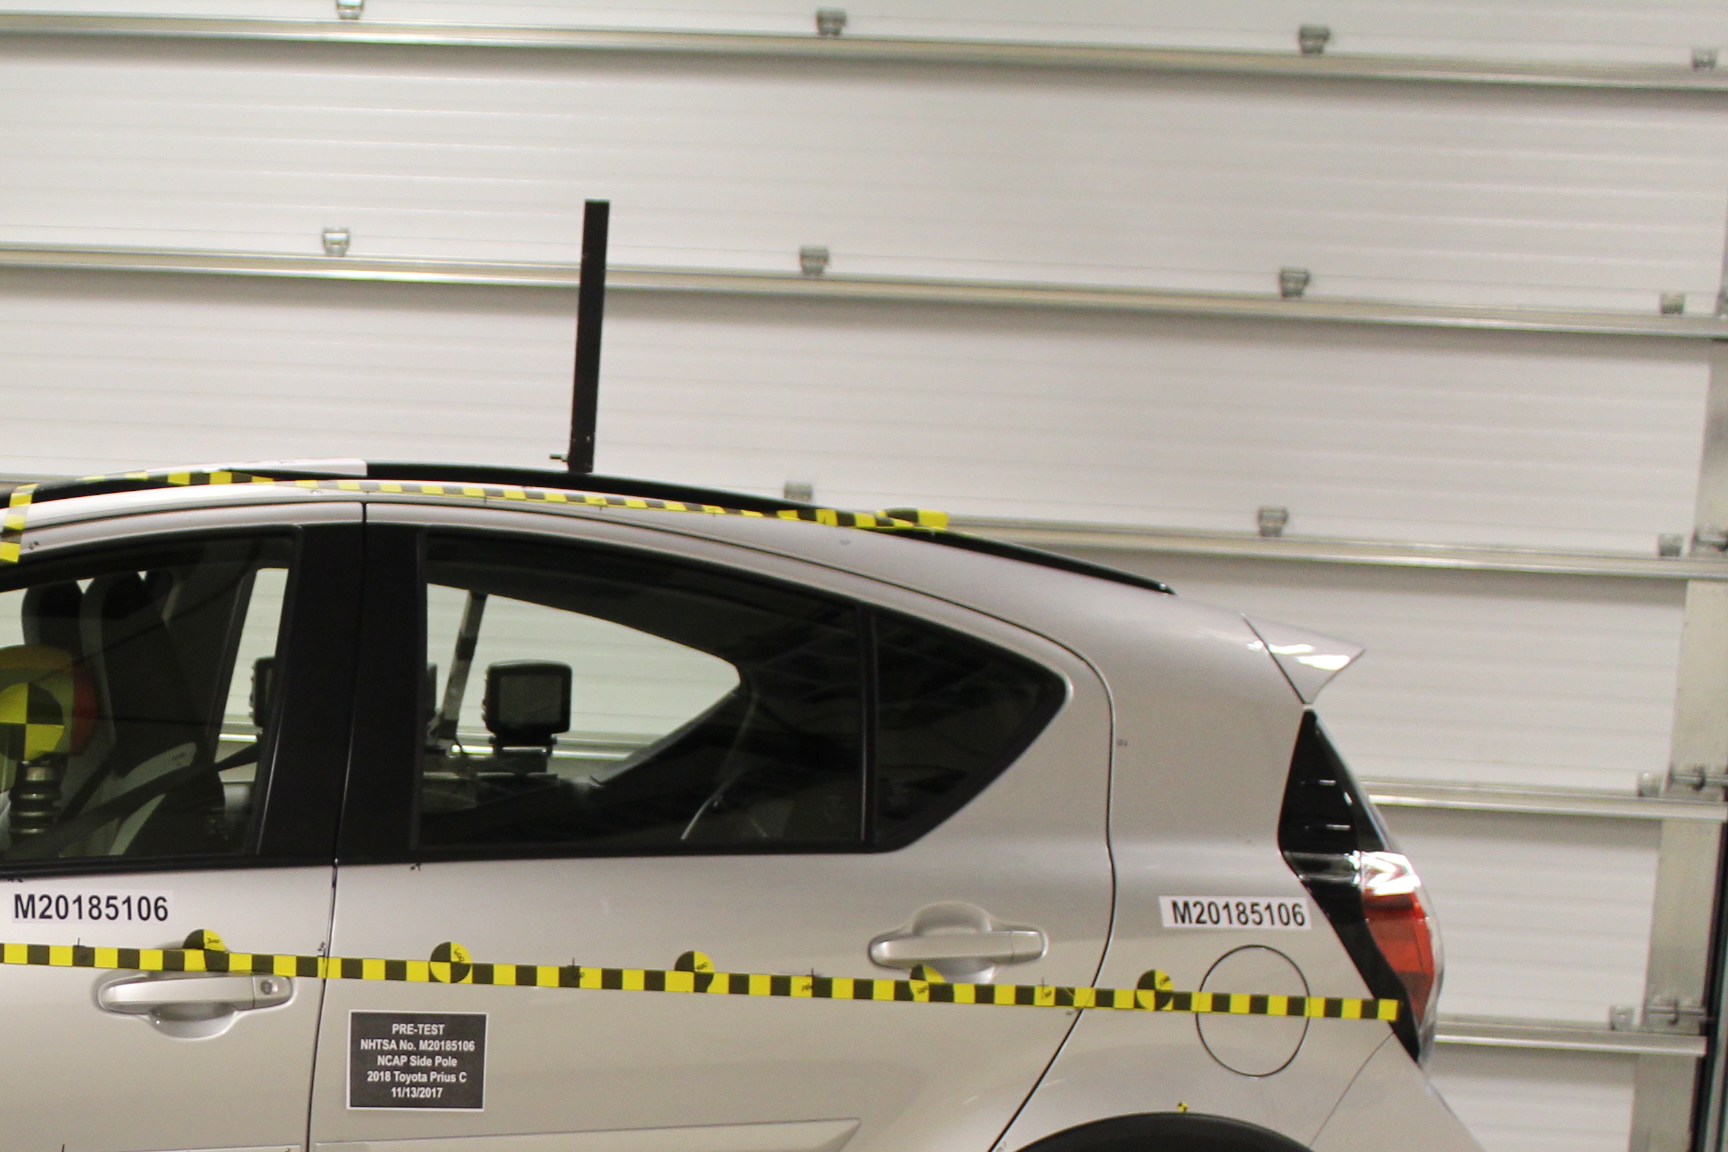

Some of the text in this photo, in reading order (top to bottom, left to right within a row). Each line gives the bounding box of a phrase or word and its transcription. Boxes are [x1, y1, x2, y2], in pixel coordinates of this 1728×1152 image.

[14, 893, 169, 922] M20185106
[1171, 900, 1306, 926] M20185106
[392, 1023, 445, 1035] PRE-TEST
[360, 1039, 475, 1052] NHTSA No. M20185106
[377, 1055, 458, 1067] NCAP Side Pole
[367, 1071, 468, 1084] 2018 Toyota Prius C
[391, 1087, 443, 1098] 11/13/2017
